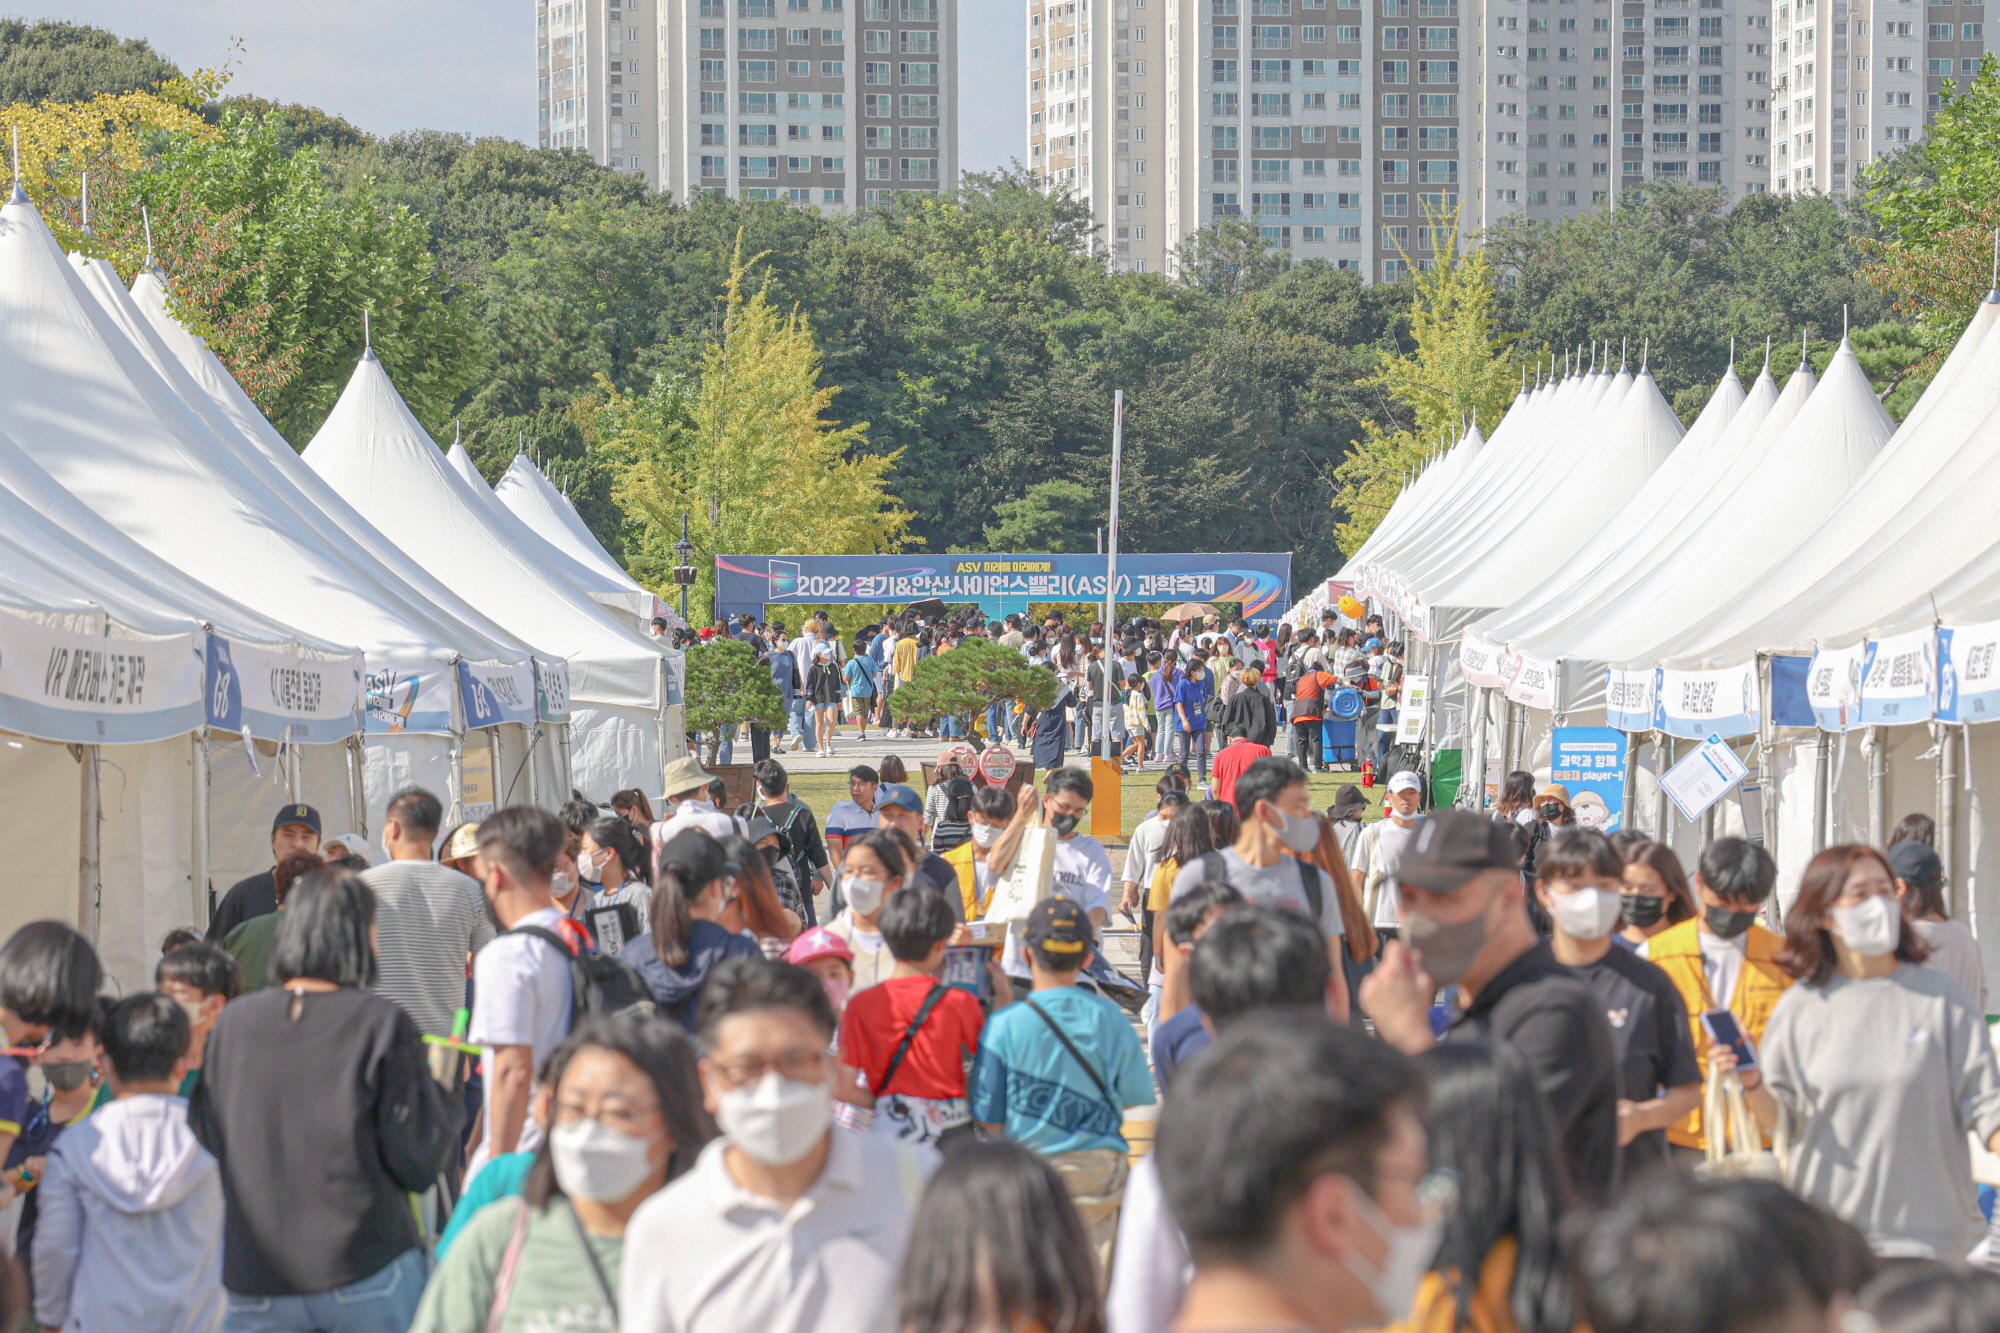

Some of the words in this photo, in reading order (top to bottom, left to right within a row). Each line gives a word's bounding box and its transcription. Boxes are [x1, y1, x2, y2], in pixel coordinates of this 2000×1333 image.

[956, 562, 981, 573] ASV
[984, 561, 1011, 573] 미래를
[1012, 561, 1051, 573] 미래에게!
[796, 575, 851, 597] 2022
[856, 573, 1132, 598] 경기&안산사이언스밸리(ASV)
[1138, 574, 1216, 597] 과학축제
[45, 646, 68, 696] VR
[65, 648, 107, 704] 메타버스
[127, 655, 145, 705] 제작
[365, 671, 396, 694] ASV
[212, 670, 231, 720] G8
[280, 667, 303, 711] 자율주행
[1559, 754, 1592, 768] 과학과
[1595, 754, 1617, 768] 함께
[1553, 770, 1581, 781] 문화재
[1583, 770, 1624, 781] player~!!
